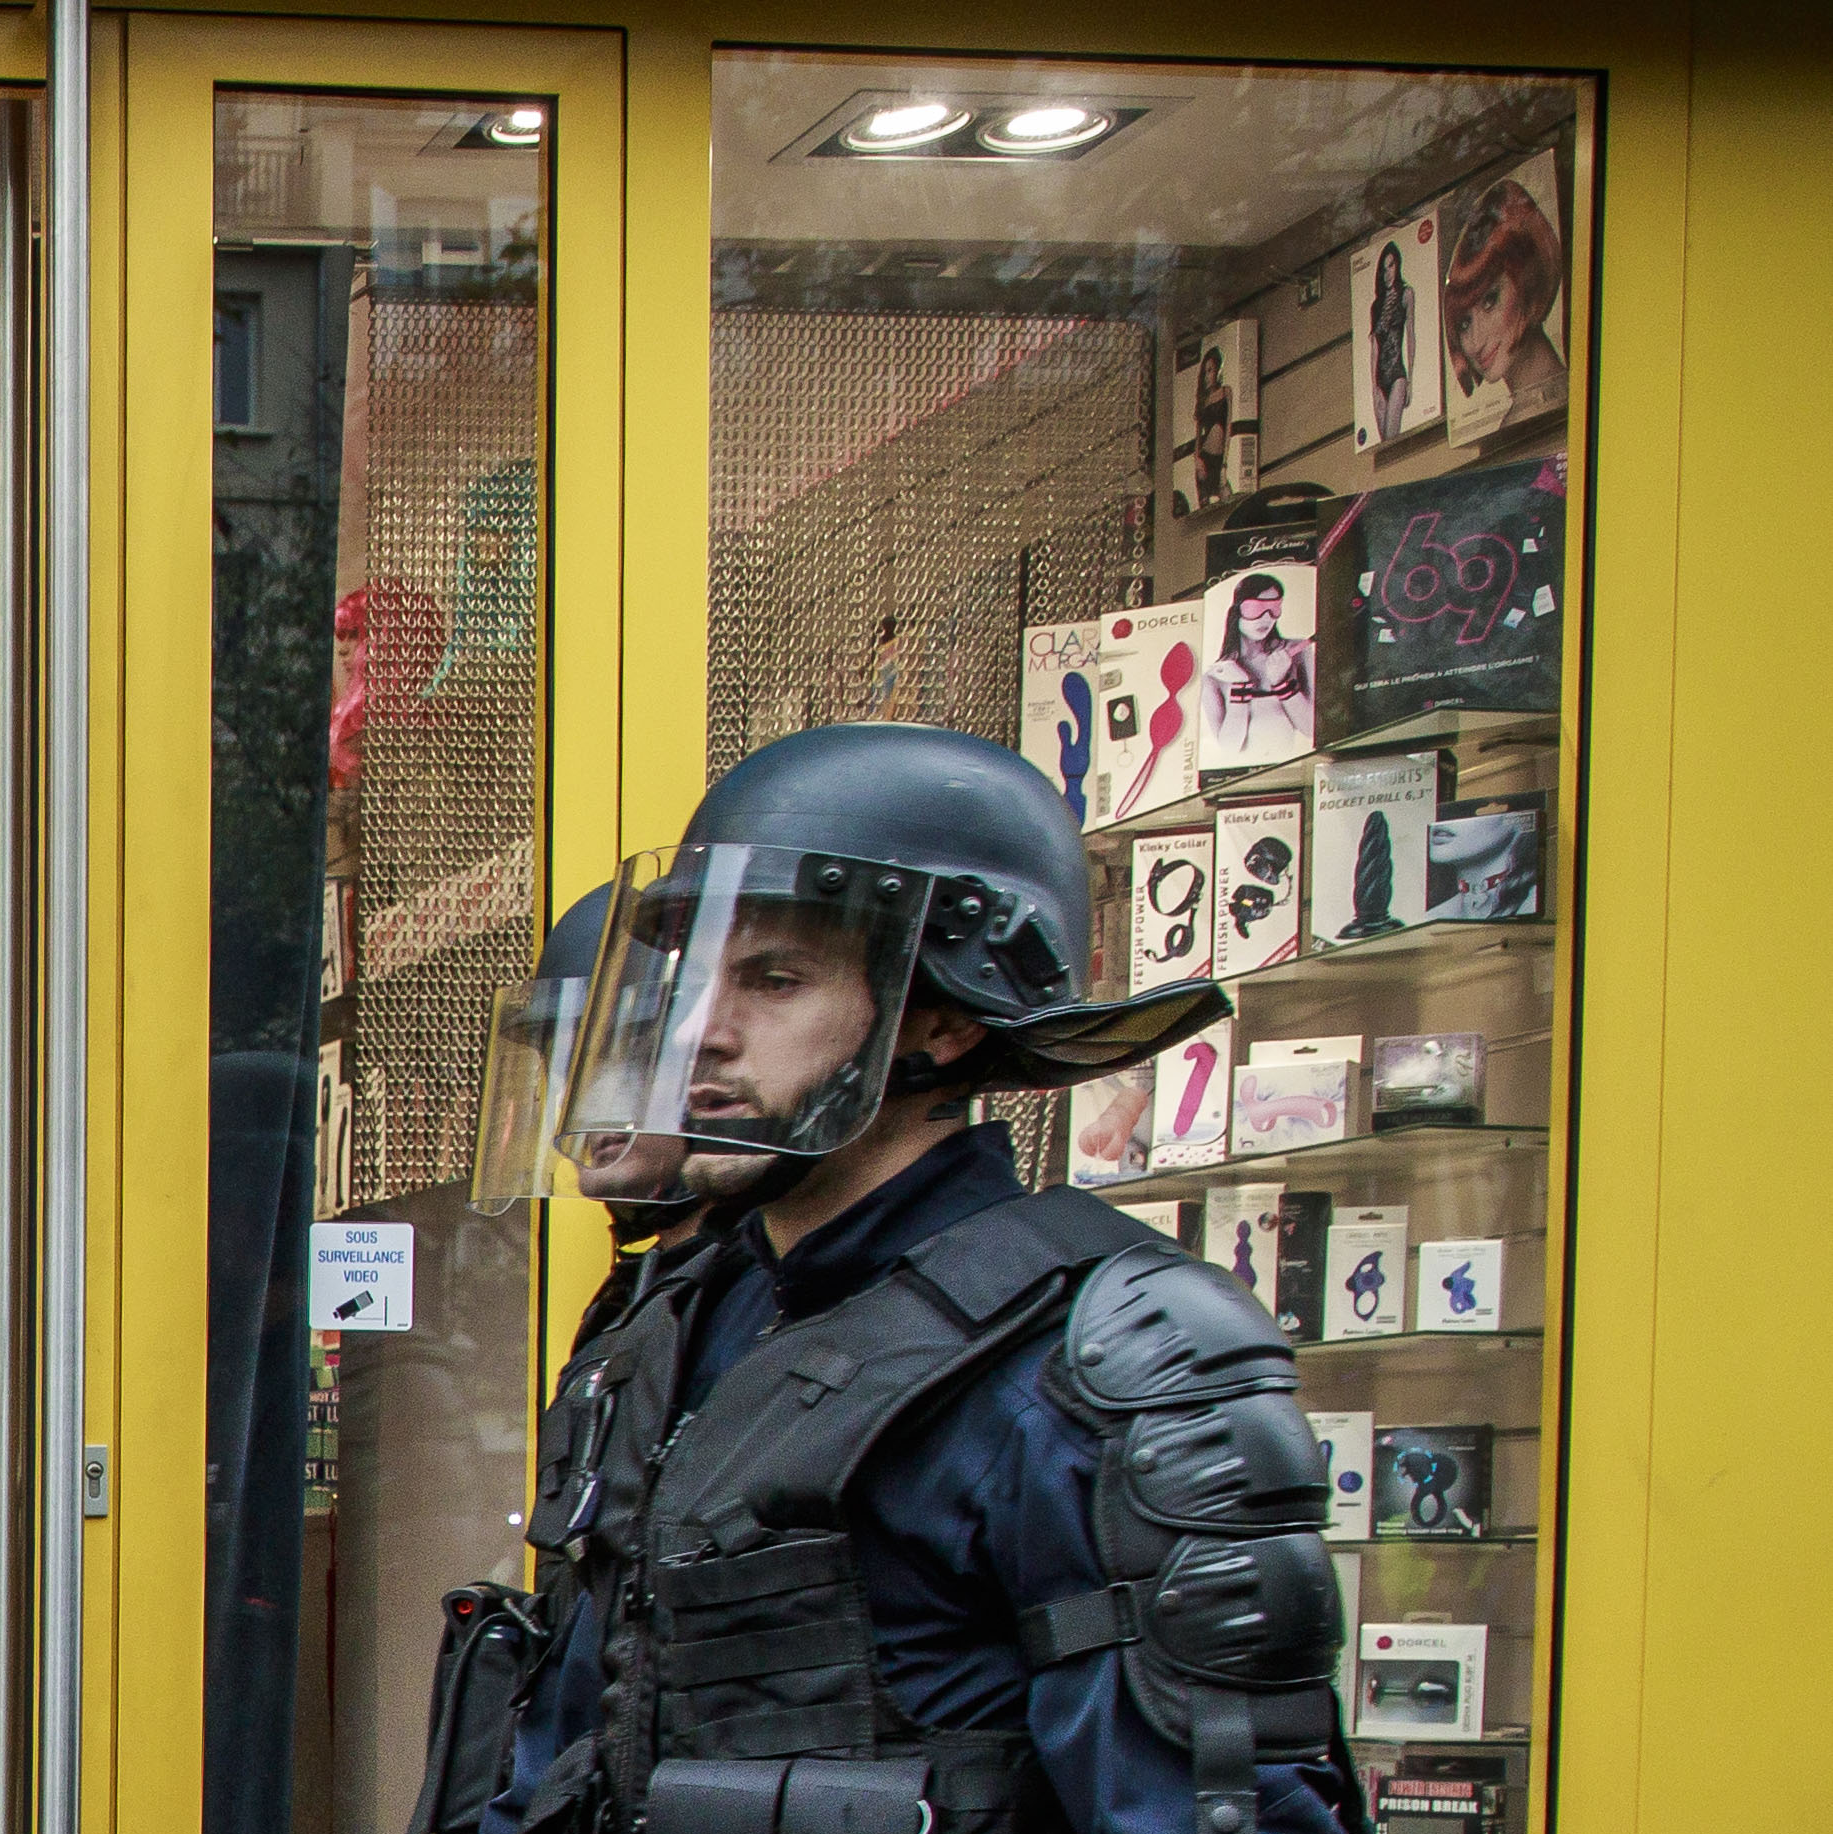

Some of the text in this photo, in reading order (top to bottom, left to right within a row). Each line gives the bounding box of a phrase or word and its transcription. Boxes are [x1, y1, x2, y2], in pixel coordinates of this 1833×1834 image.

[1137, 612, 1198, 631] DORCEL
[1319, 795, 1366, 812] ROCKET
[1368, 790, 1402, 806] DRILL
[1223, 809, 1294, 825] Kinky Cuffs
[1139, 839, 1208, 853] Kinky Collar
[1217, 867, 1230, 971] FETISH POWER
[1133, 887, 1145, 985] FETISH POWER
[345, 1231, 378, 1245] SOUS
[318, 1250, 405, 1264] SURVEILLANCE
[343, 1270, 379, 1284] VIDEO
[1396, 1637, 1447, 1648] DORCEL
[1432, 1799, 1479, 1814] BREAK
